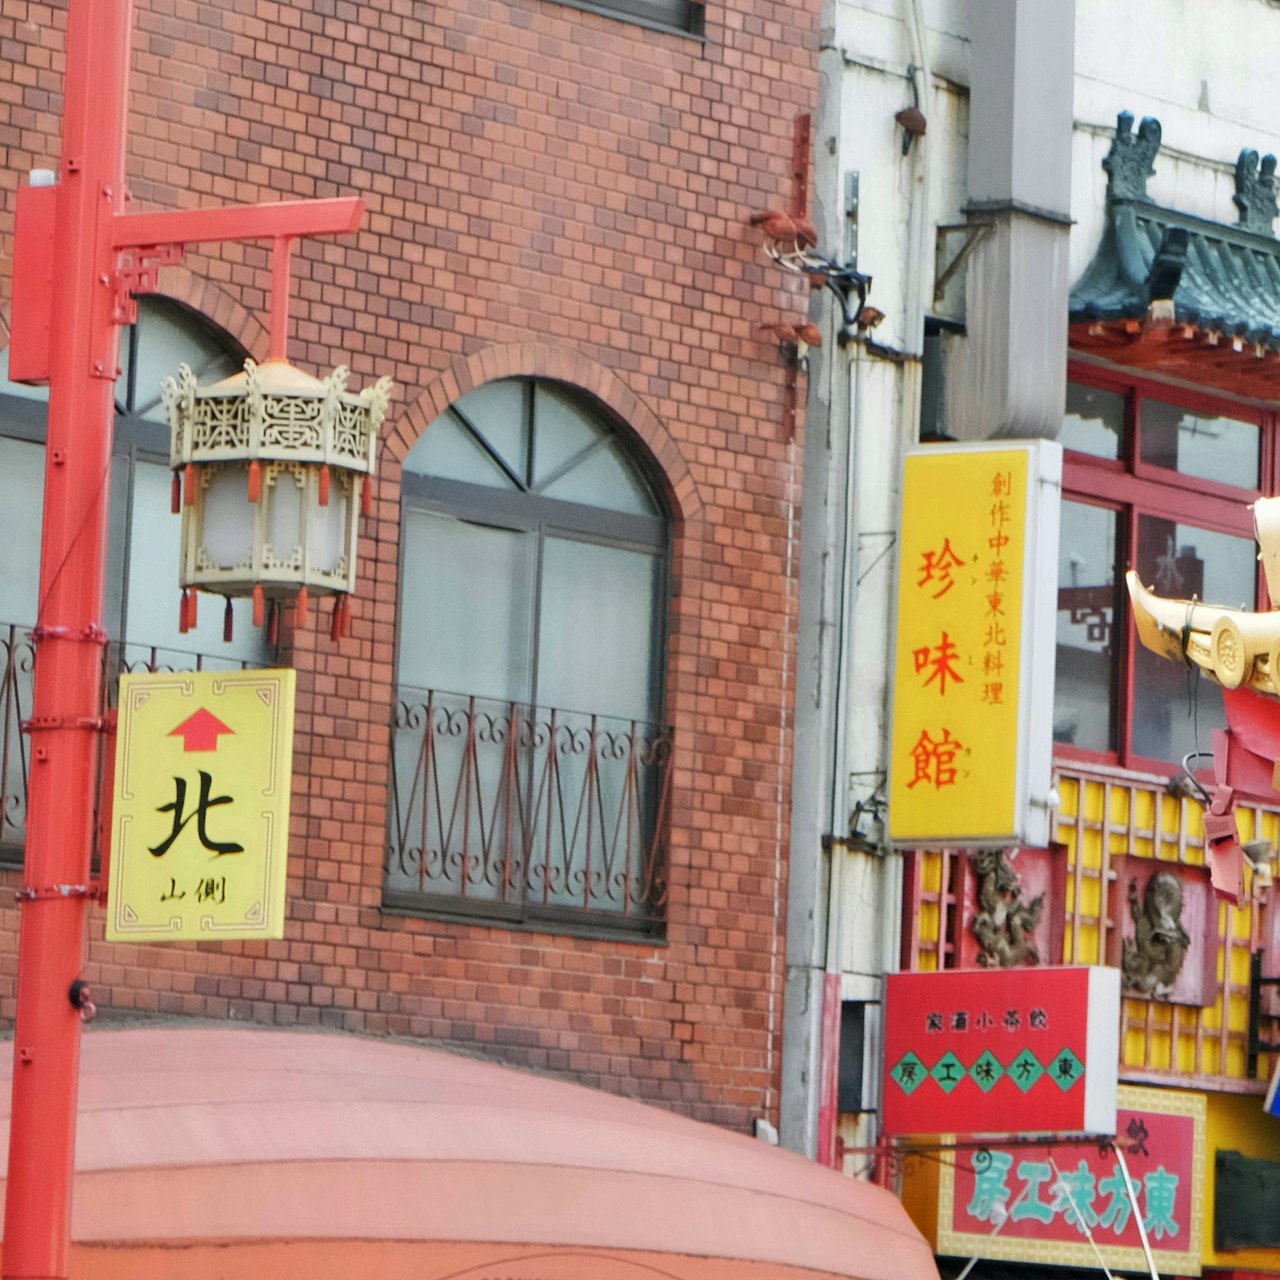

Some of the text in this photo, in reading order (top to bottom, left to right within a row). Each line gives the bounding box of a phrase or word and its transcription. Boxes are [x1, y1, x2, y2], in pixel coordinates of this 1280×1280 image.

[906, 537, 966, 791] 珍味館
[980, 472, 1012, 706] 創作中華東北料理
[148, 769, 244, 861] 北
[160, 877, 226, 904] 山側
